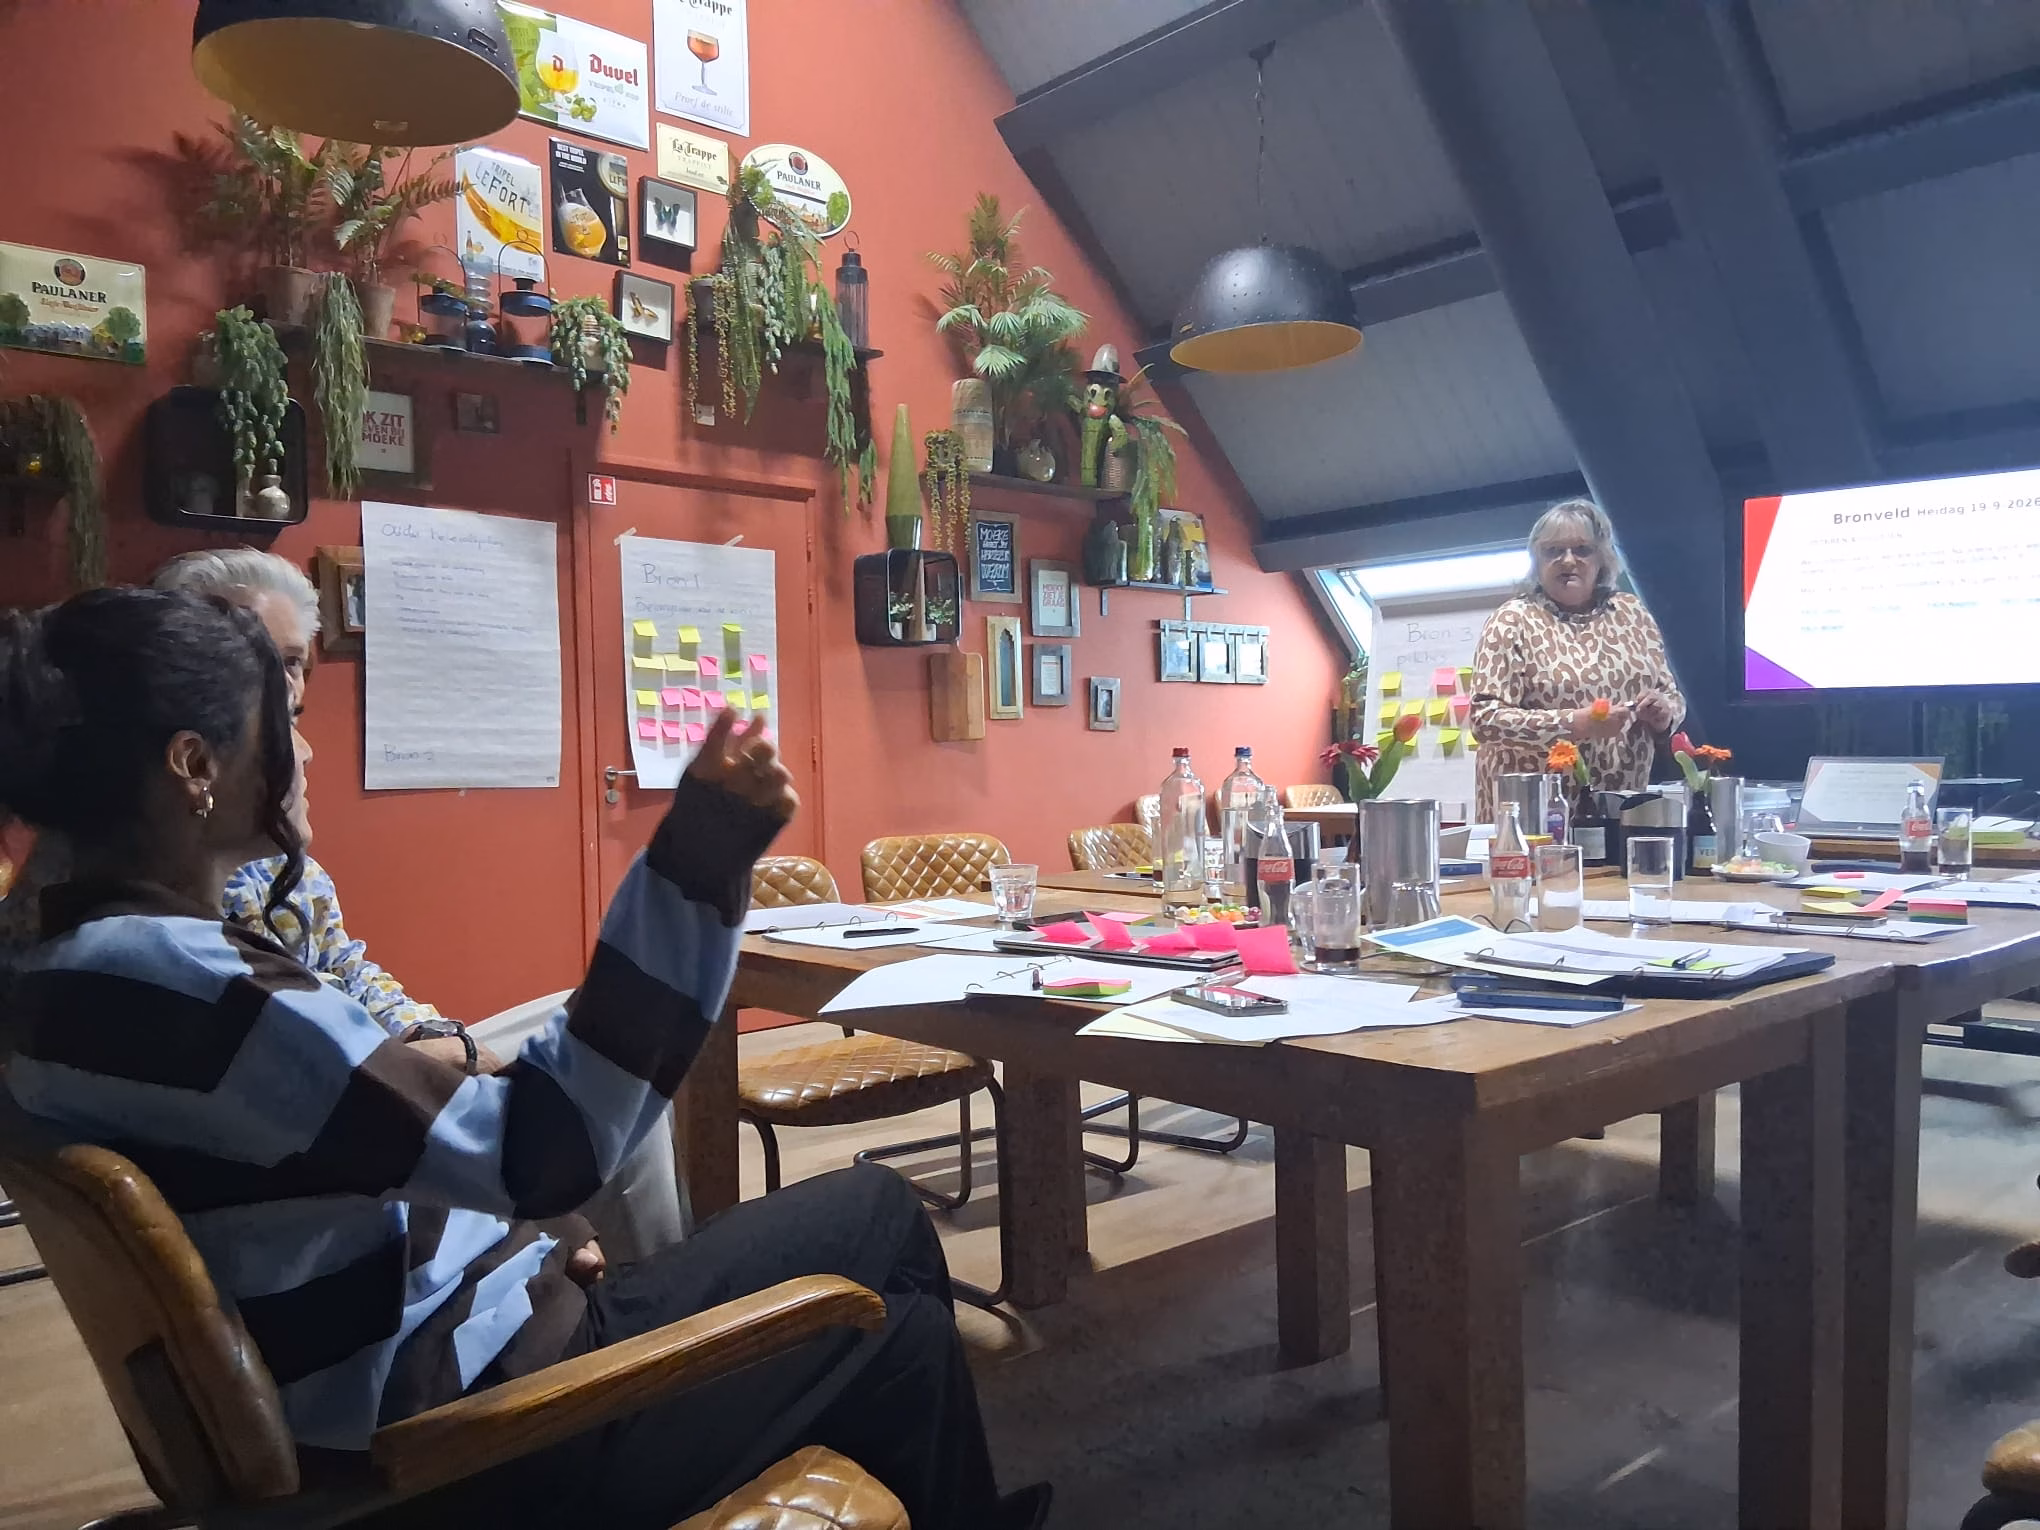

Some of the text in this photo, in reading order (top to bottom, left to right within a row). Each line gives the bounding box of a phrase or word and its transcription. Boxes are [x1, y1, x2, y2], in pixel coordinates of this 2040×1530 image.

[588, 53, 639, 87] Duvel
[672, 138, 717, 161] La Trappe
[491, 162, 515, 187] TRIPEL
[776, 170, 822, 191] PAULANER
[31, 281, 107, 303] PAULANER
[380, 412, 405, 428] ZIT
[361, 432, 405, 447] MOEKE
[1833, 507, 1910, 525] Bronveld
[1917, 505, 1965, 516] Heidag
[980, 527, 1009, 541] MOEKE
[1407, 622, 1474, 643] Bron 3
